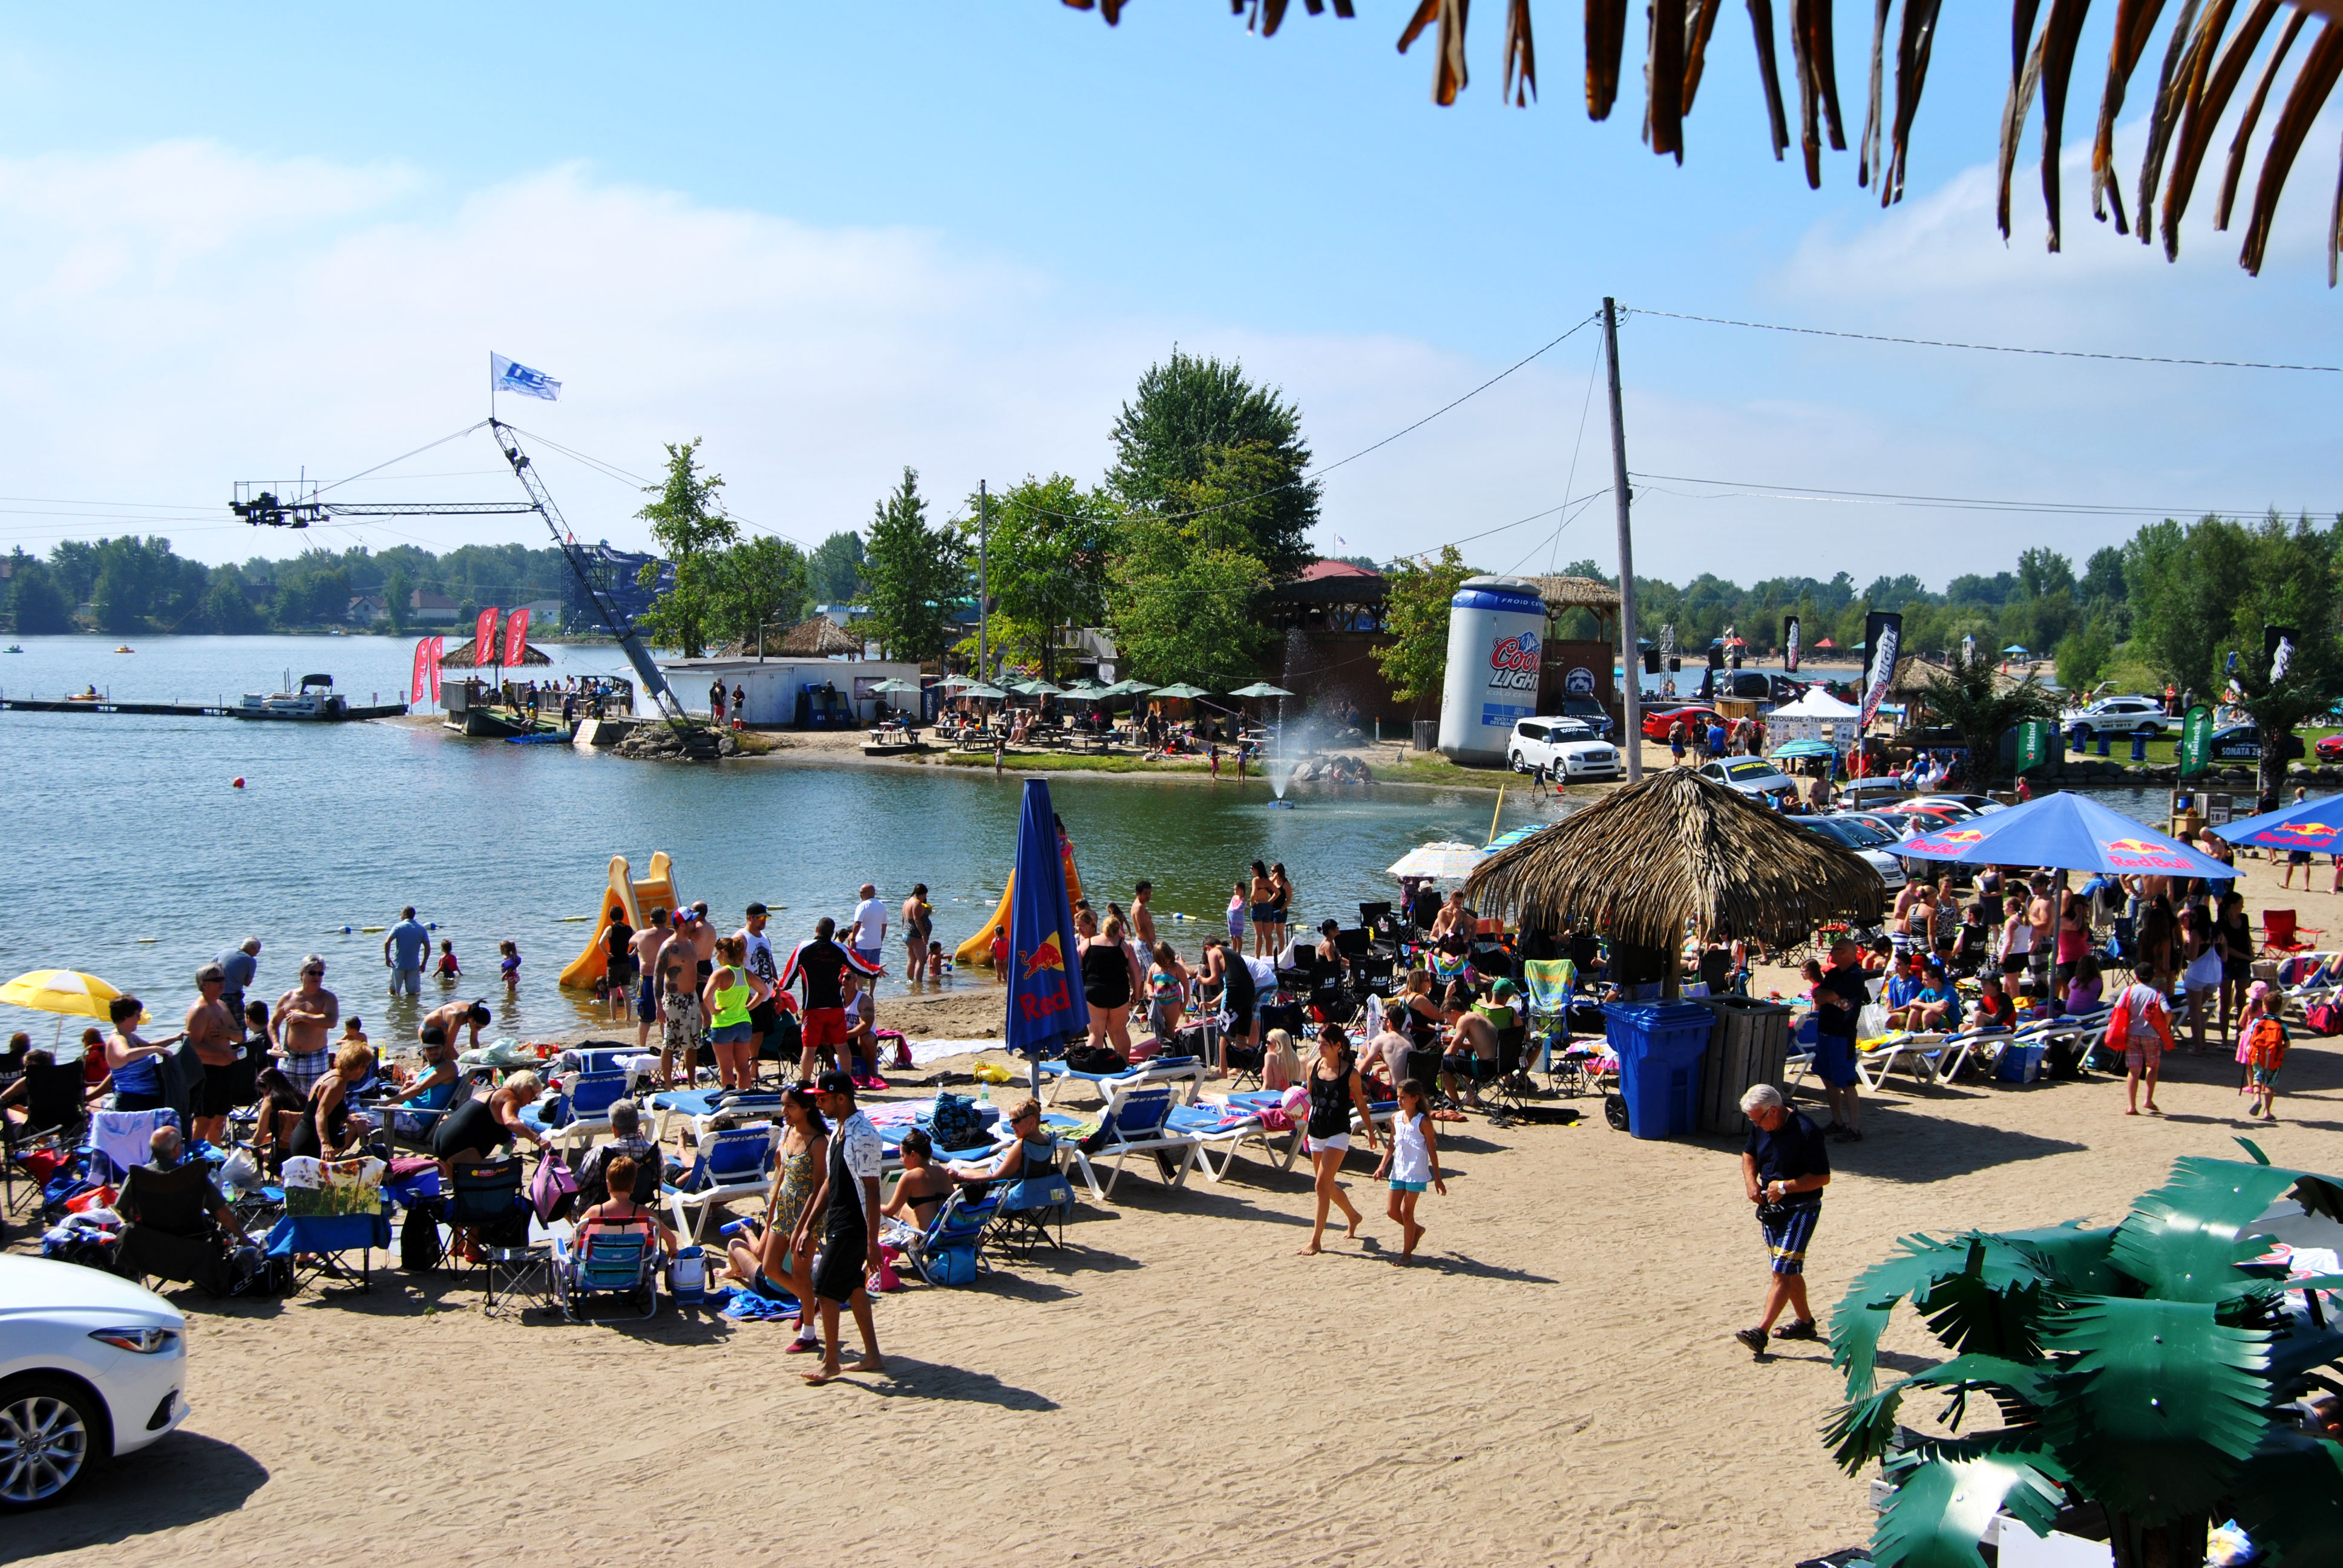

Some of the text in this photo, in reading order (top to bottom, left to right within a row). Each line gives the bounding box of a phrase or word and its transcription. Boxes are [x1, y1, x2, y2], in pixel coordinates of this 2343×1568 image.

[1878, 624, 1898, 684] LIGHT
[1489, 670, 1539, 691] LIGHT
[2221, 747, 2250, 756] SONATA
[1904, 839, 1941, 852] Red
[2254, 832, 2333, 848] Red Bull
[2108, 855, 2195, 870] Red Bull
[1018, 979, 1070, 1022] Red
